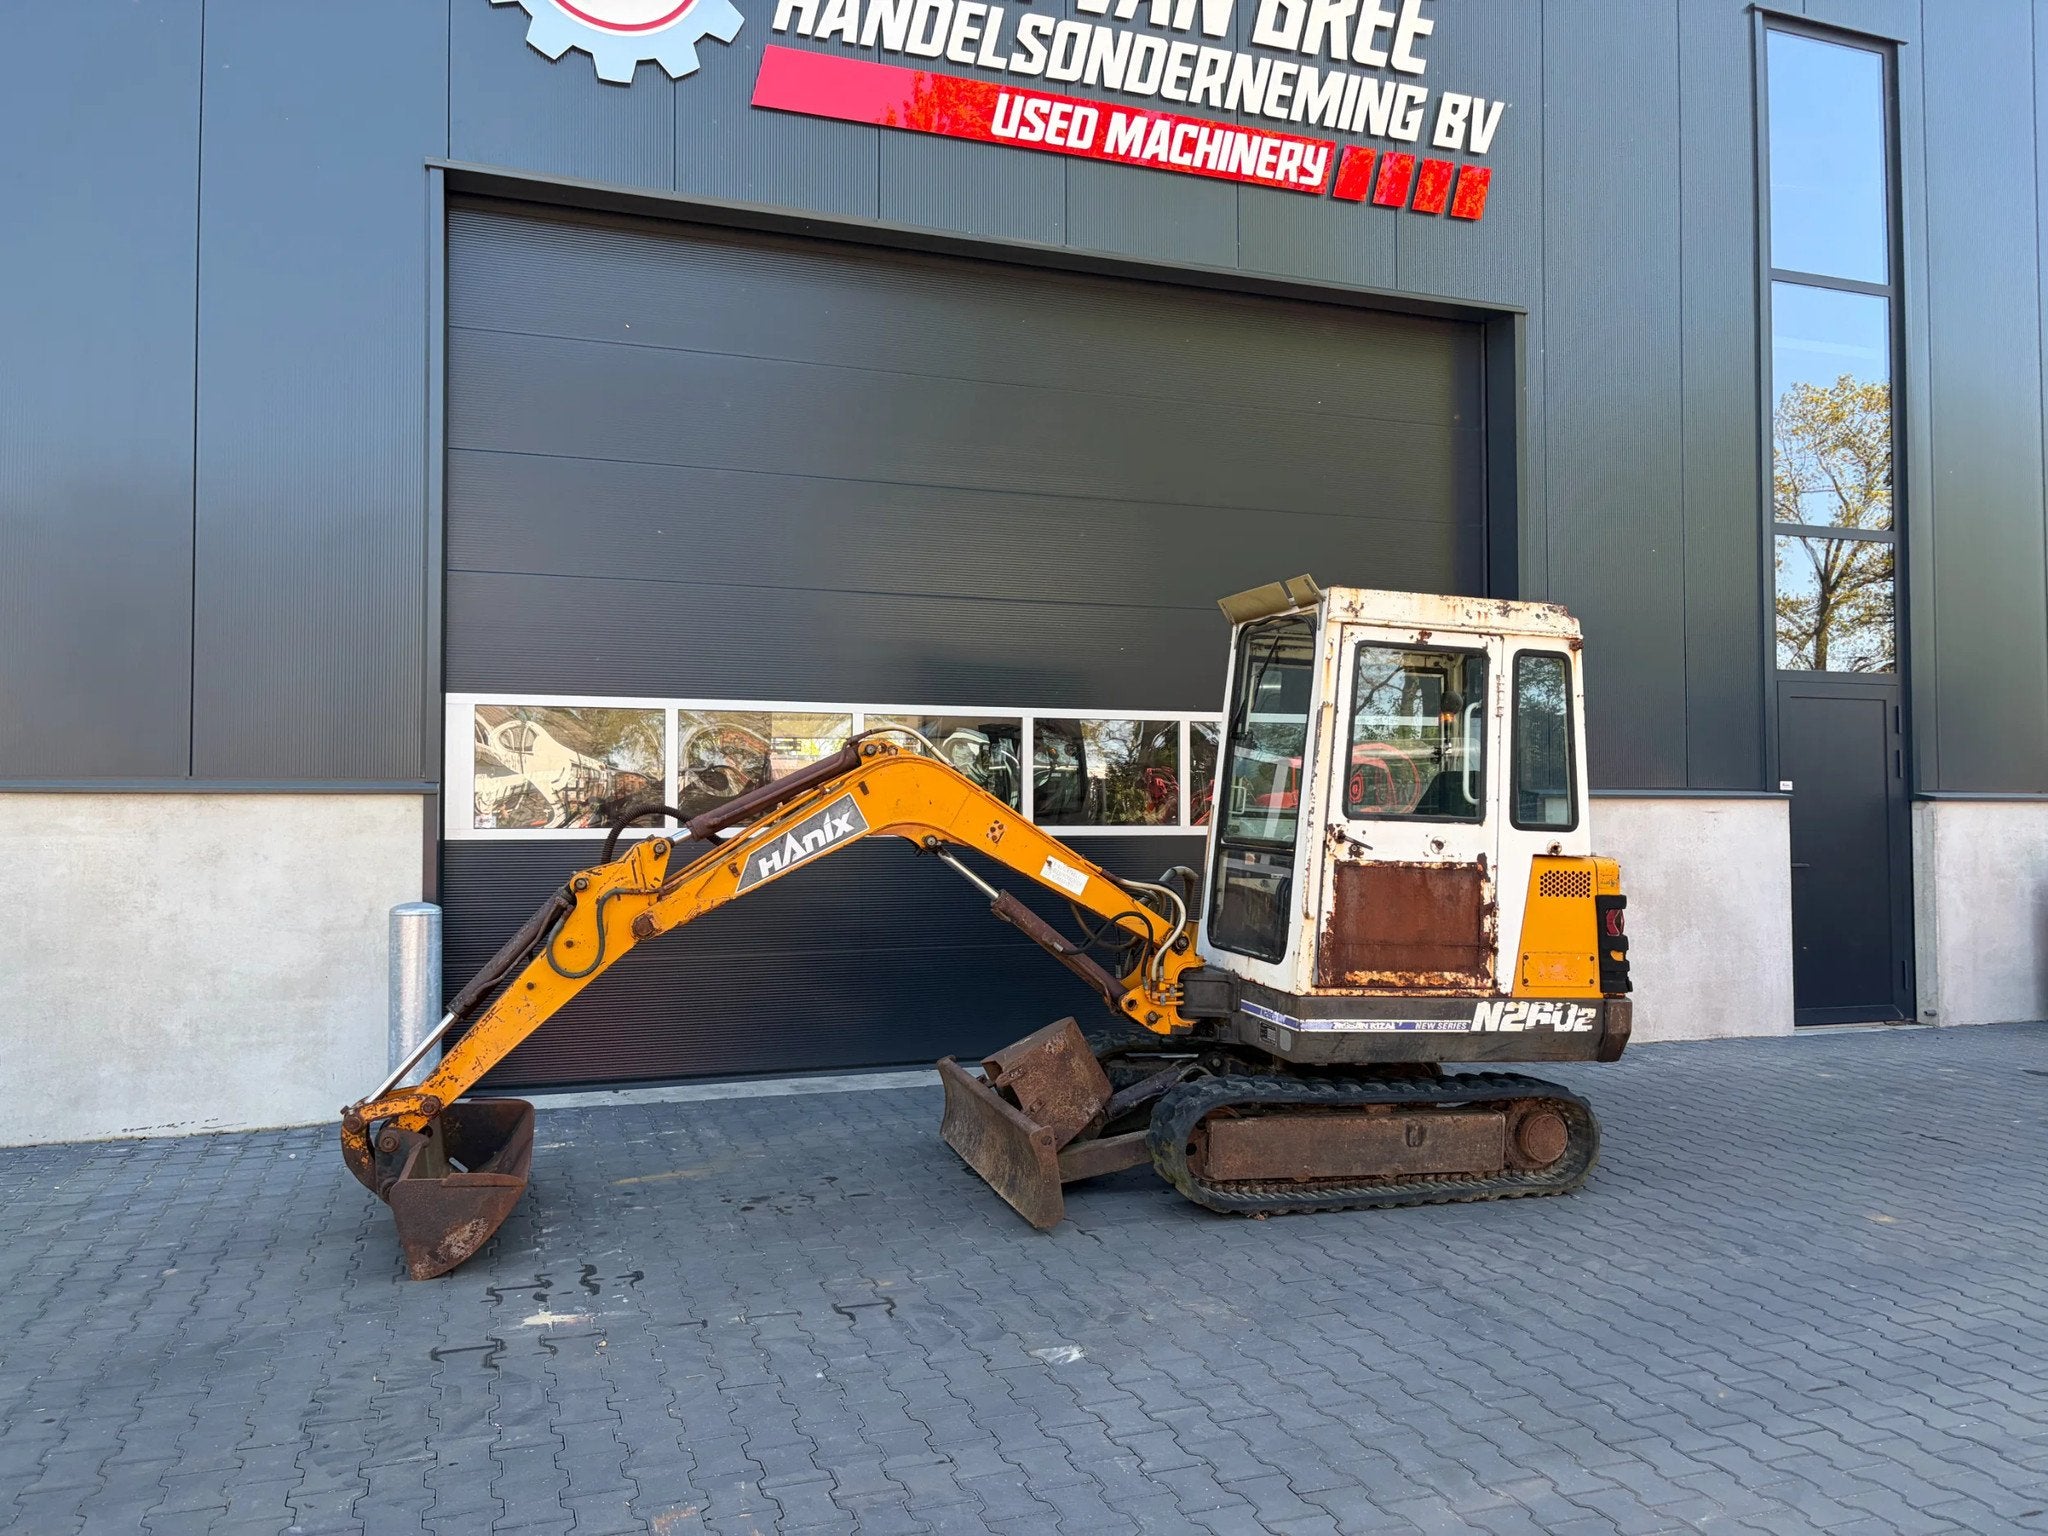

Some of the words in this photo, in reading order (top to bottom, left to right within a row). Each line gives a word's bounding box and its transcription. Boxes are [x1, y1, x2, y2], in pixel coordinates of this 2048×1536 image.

[991, 94, 1098, 150] USED
[1103, 111, 1330, 187] MACHINERY
[1433, 91, 1505, 154] BV
[1415, 1021, 1436, 1030] NEW
[1436, 1021, 1468, 1030] SERIES
